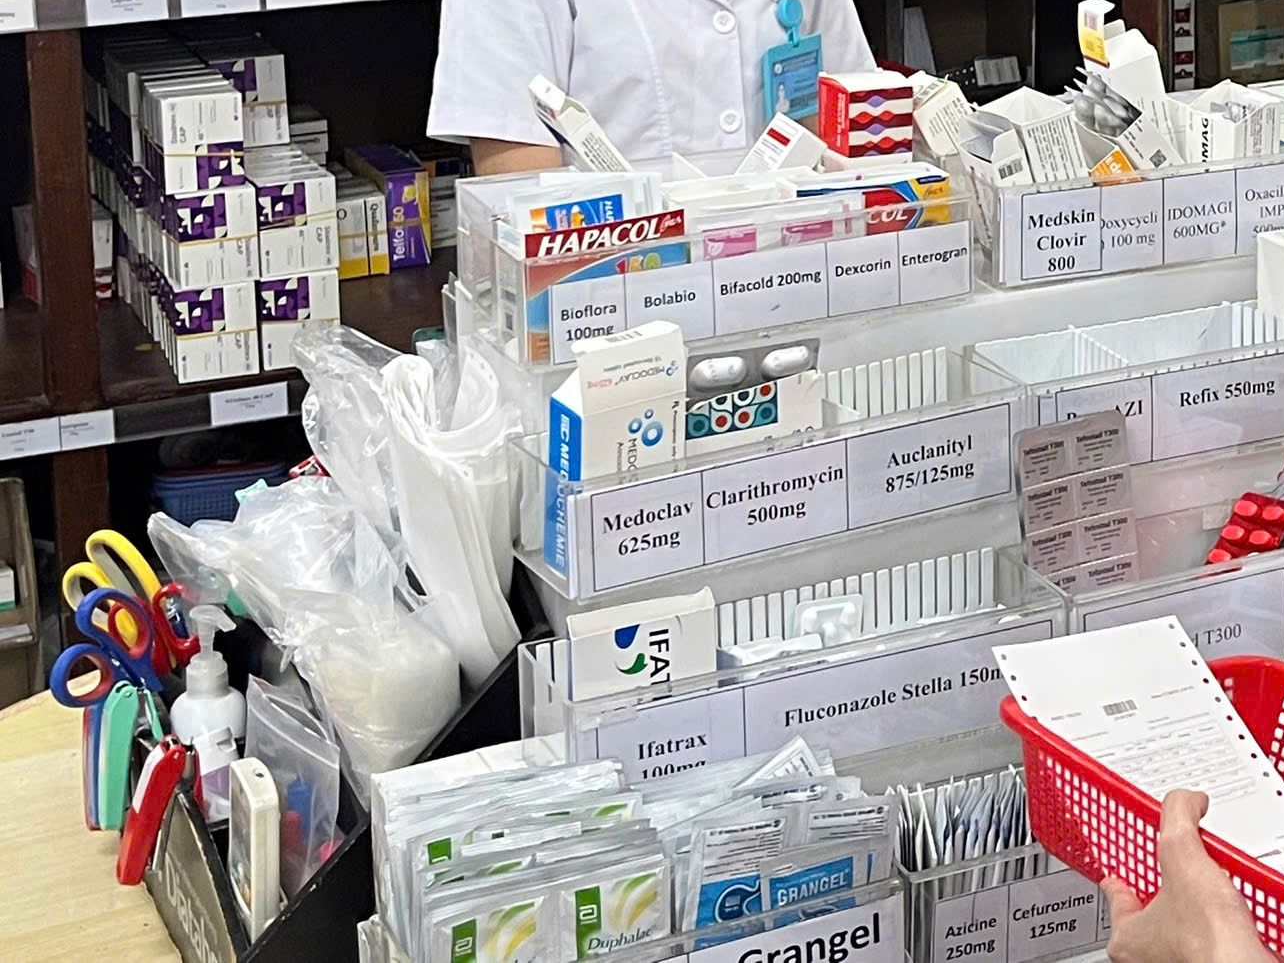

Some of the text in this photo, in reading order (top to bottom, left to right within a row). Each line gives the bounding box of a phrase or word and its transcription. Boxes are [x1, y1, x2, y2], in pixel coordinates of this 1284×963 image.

[1027, 208, 1095, 231] Medskin
[538, 217, 661, 258] HAPACOL
[1037, 232, 1087, 252] Clovir
[1111, 233, 1155, 248] 100 mg
[834, 257, 892, 279] Dexcorin
[901, 243, 969, 268] Enterogran
[1047, 255, 1076, 272] 800
[719, 268, 822, 297] Bifacold 200mg
[560, 300, 617, 322] Bioflora
[644, 288, 696, 309] Bolabio
[565, 323, 614, 342] 100mg
[1179, 376, 1276, 409] Refix 550mg
[886, 435, 974, 469] Auclanityl
[705, 465, 845, 511] Clarithromycin
[884, 459, 976, 494] 875/125mg
[601, 501, 694, 534] Medoclav
[747, 500, 806, 527] 500mg
[618, 530, 682, 557] 625mg
[1204, 623, 1242, 646] T300
[783, 687, 898, 728] Fluconazole
[902, 675, 953, 702] Stella
[637, 733, 708, 760] Ifatrax
[1011, 890, 1096, 923] Cefuroxime
[738, 911, 881, 963] Grangel
[945, 915, 998, 940] Azicine
[1028, 917, 1078, 942] 125mg
[946, 938, 996, 962] 250mg
